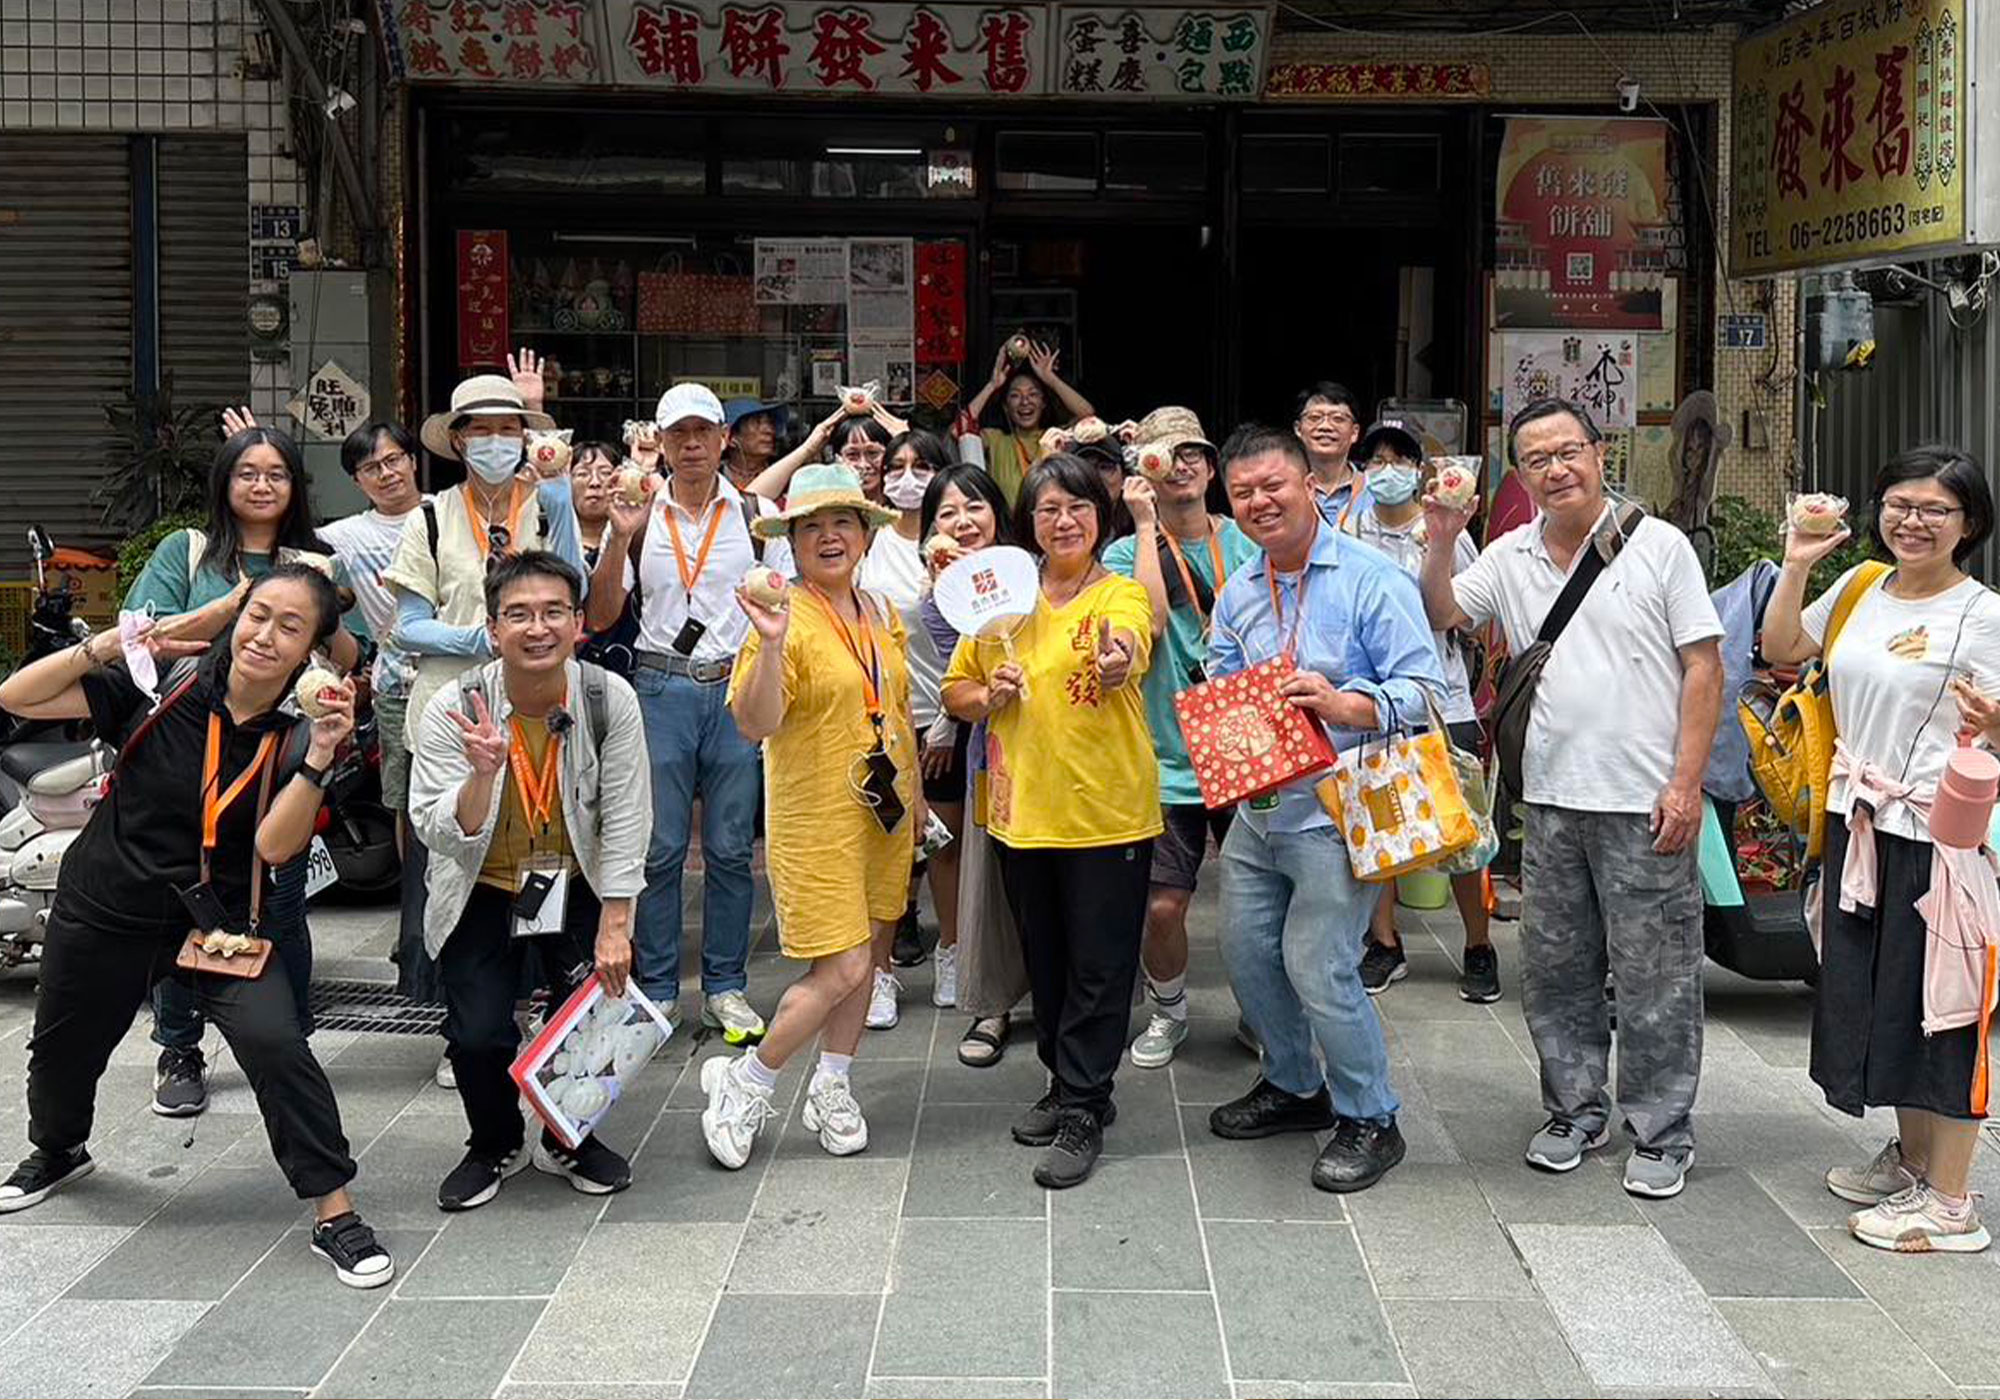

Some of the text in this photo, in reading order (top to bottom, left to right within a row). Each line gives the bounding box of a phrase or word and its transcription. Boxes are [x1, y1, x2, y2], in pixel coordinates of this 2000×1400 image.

[273, 220, 291, 238] 13
[1789, 203, 1906, 250] 06-2258663
[271, 260, 289, 278] 15
[1738, 329, 1755, 346] 17
